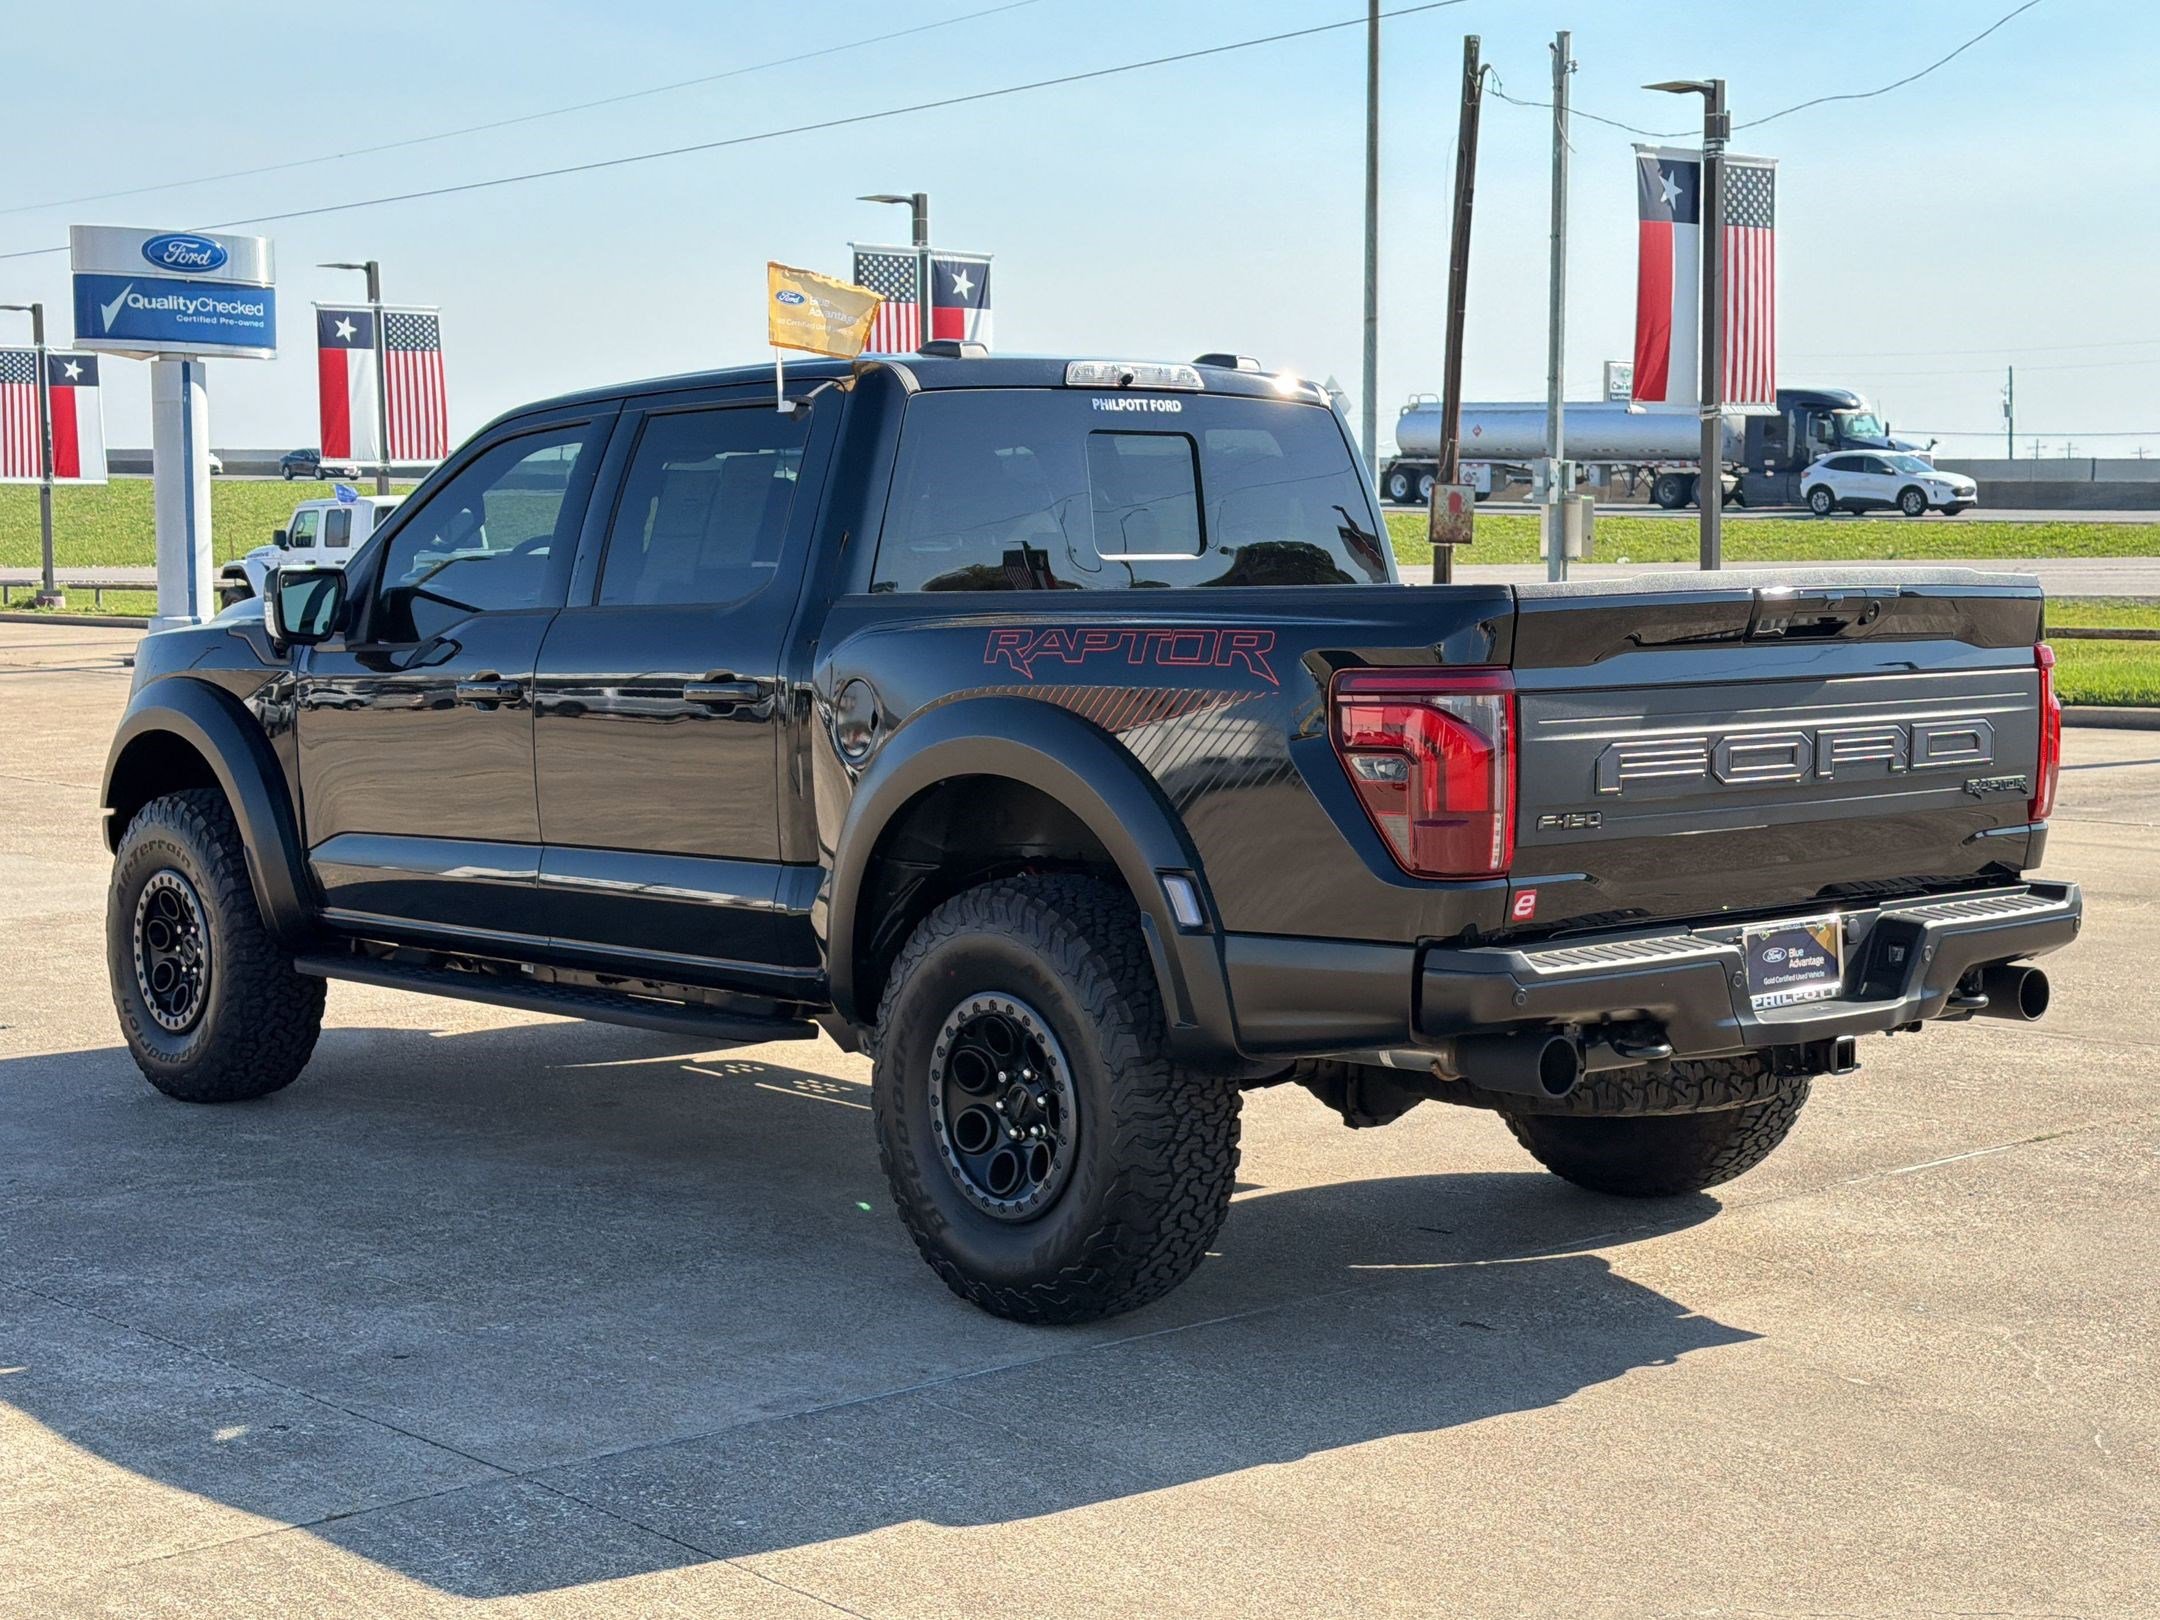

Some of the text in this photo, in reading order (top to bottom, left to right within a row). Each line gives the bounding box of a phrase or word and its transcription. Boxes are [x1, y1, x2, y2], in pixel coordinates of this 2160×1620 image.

[163, 241, 212, 266] Ford
[127, 293, 264, 317] QualityChecked
[778, 291, 801, 304] Ford
[176, 314, 265, 328] Certified Pre-owned
[1091, 398, 1182, 412] PHILPOTT FORD
[984, 628, 1280, 687] RAPTOR
[1595, 717, 1996, 796] FORD
[1965, 774, 2029, 800] RAPTOR
[1537, 811, 1603, 831] F-150
[1513, 894, 1536, 916] e
[1788, 947, 1804, 958] Blue
[1788, 955, 1825, 969] Advantage
[1763, 976, 1776, 986] Gold
[1775, 974, 1796, 984] Certified
[1795, 972, 1808, 981] Used
